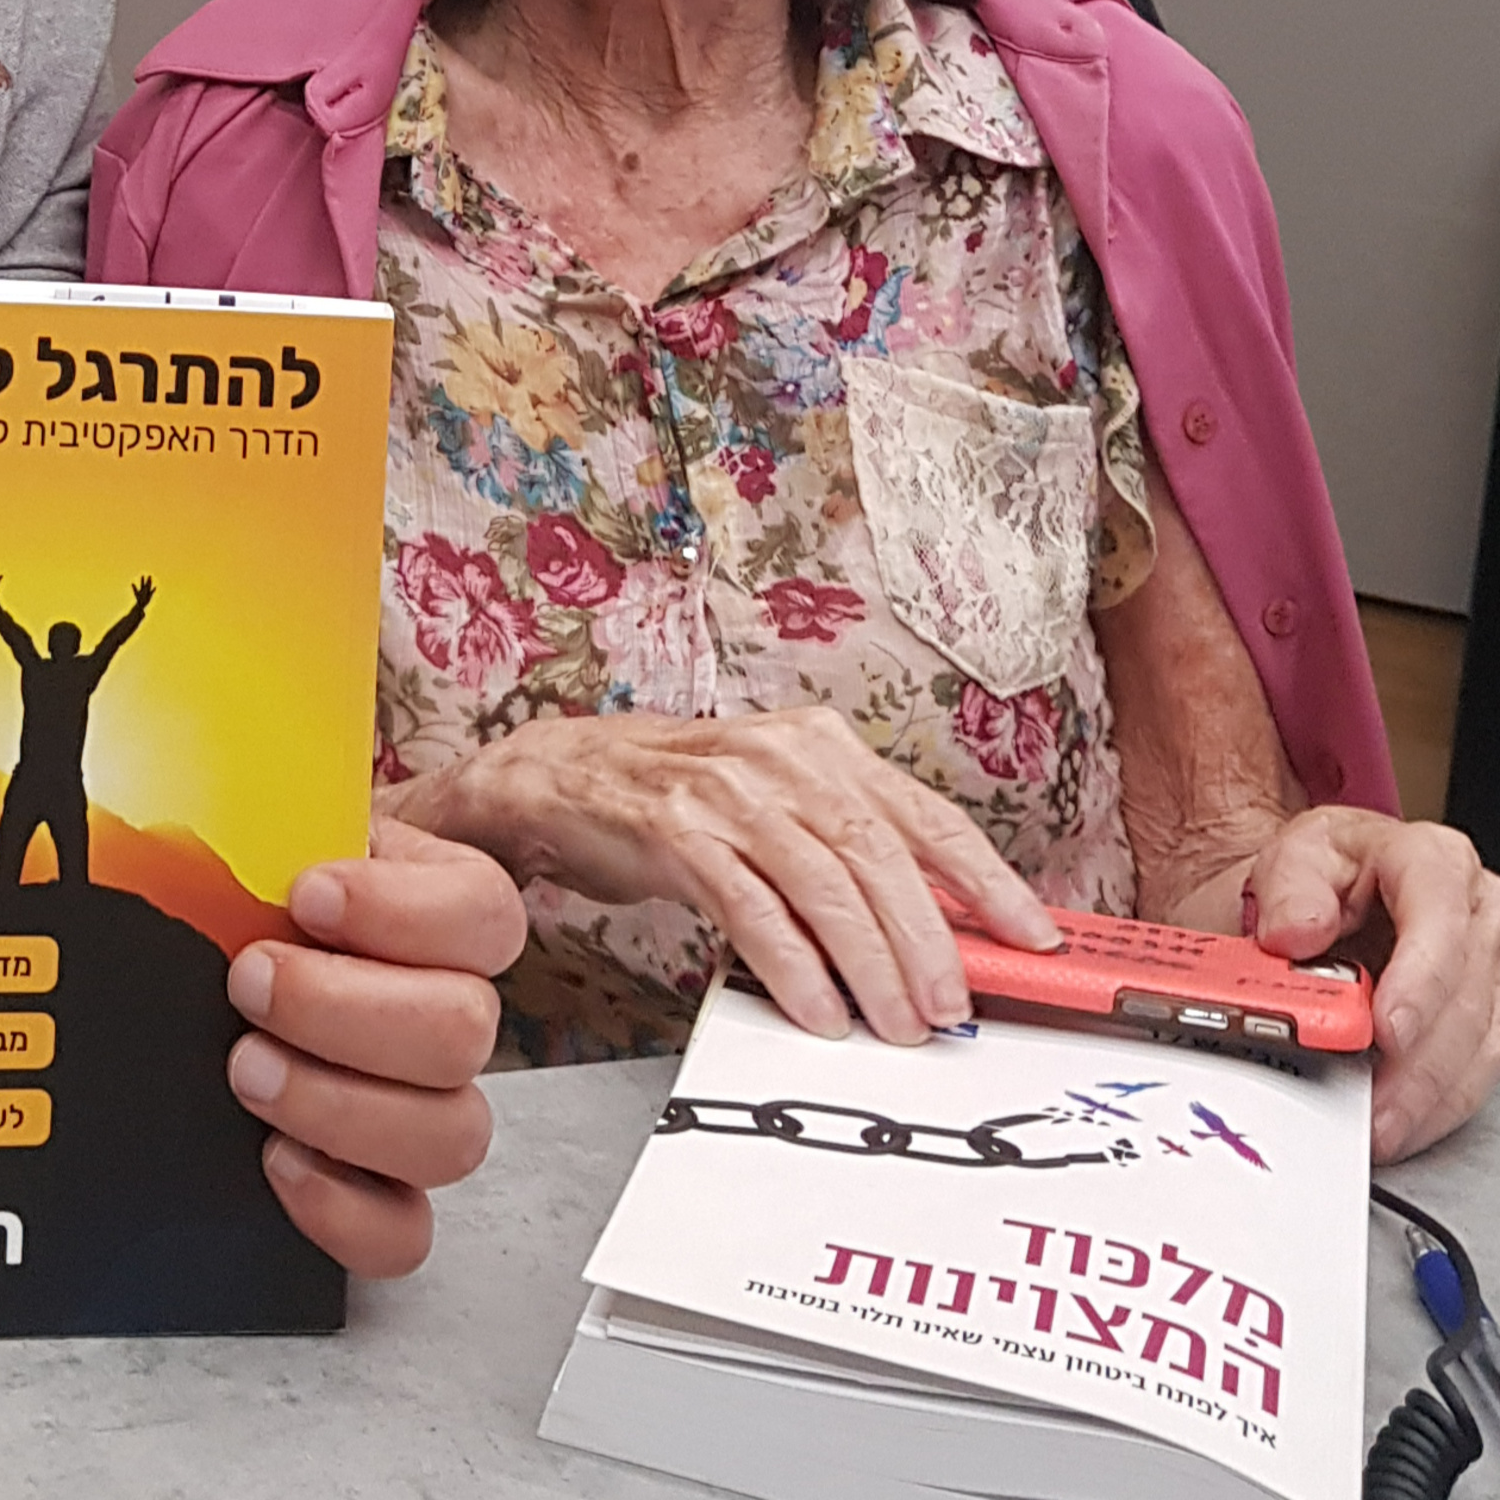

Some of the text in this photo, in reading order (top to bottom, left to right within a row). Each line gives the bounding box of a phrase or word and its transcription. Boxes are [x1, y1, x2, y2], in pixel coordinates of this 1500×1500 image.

[36, 336, 322, 410] להתרגל
[22, 415, 216, 455] האפקטיבית
[227, 421, 320, 458] הדרך
[744, 1279, 1278, 1450] איך לפתח ביטחון עצמי שאינו תלוי בנסיבות
[814, 1243, 1281, 1418] המצוינות
